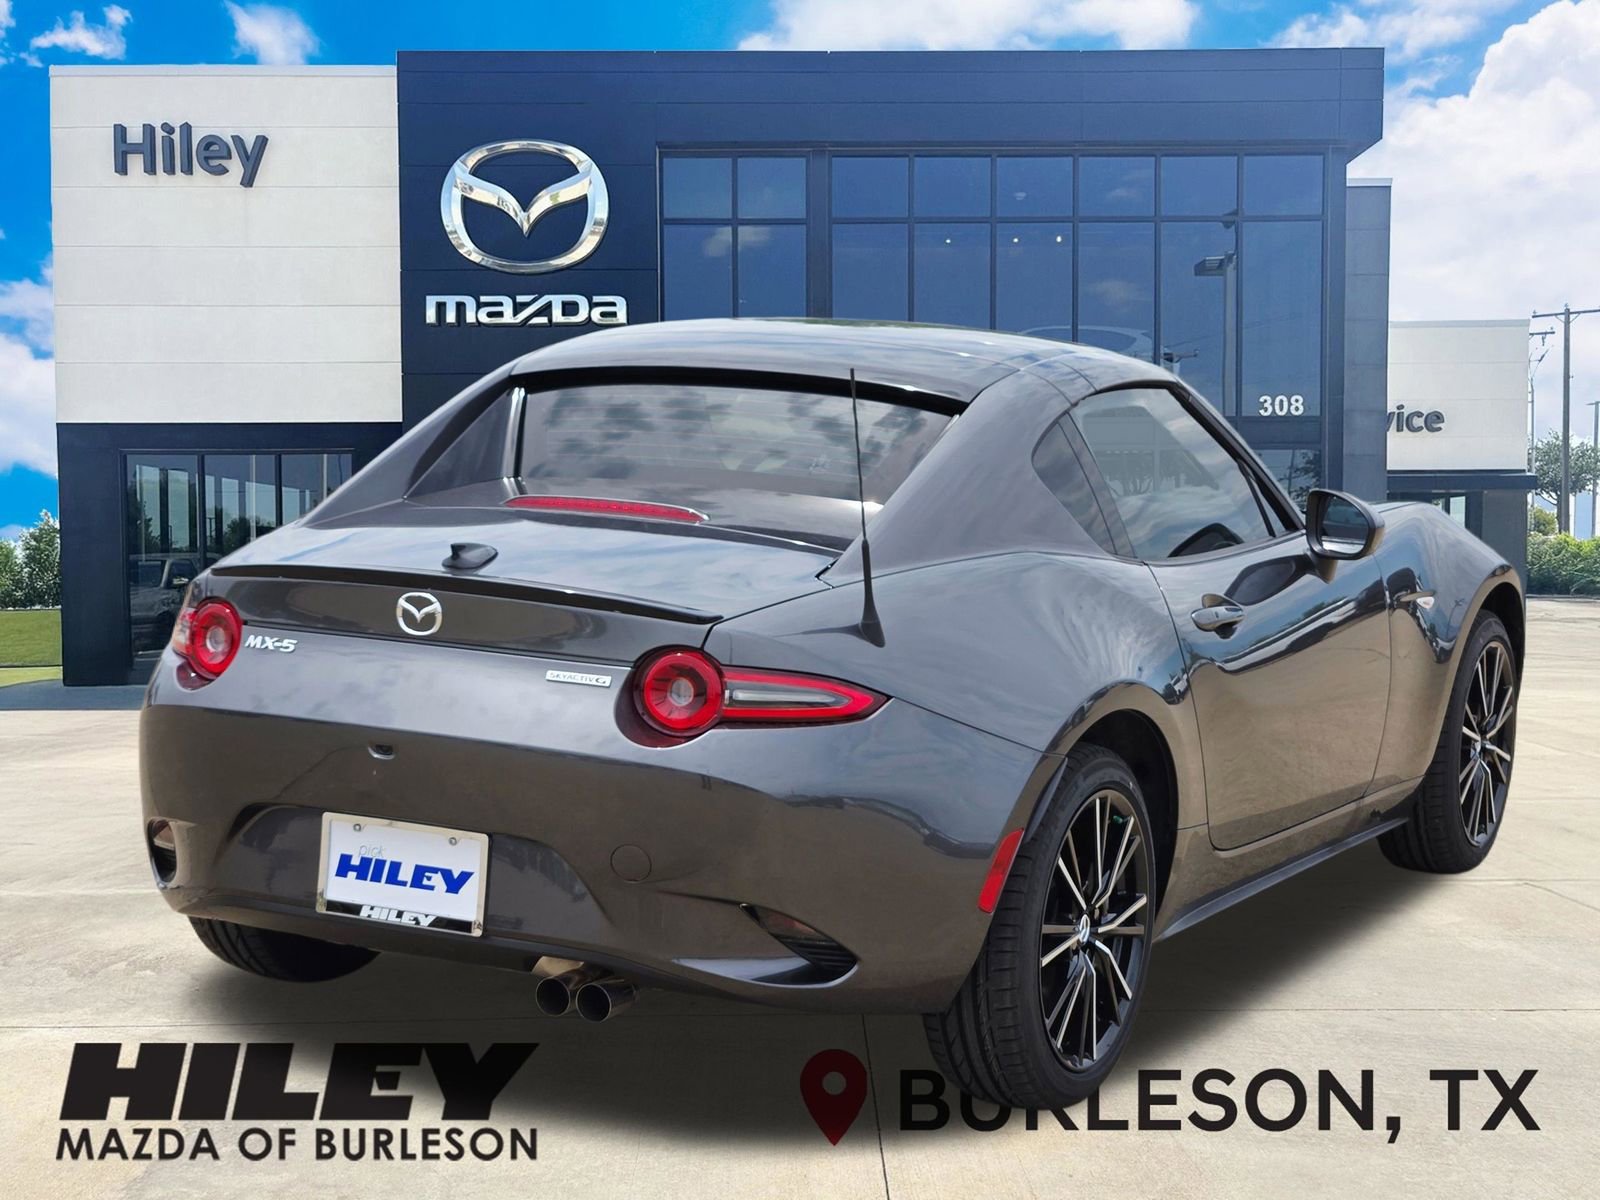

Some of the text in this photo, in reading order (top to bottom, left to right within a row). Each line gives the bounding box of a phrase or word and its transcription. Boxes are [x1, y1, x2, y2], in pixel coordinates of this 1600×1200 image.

[113, 122, 270, 188] Hiley
[1258, 394, 1306, 418] 308
[244, 634, 298, 653] MX-5
[335, 853, 475, 894] HILEY
[359, 903, 438, 927] HILEY
